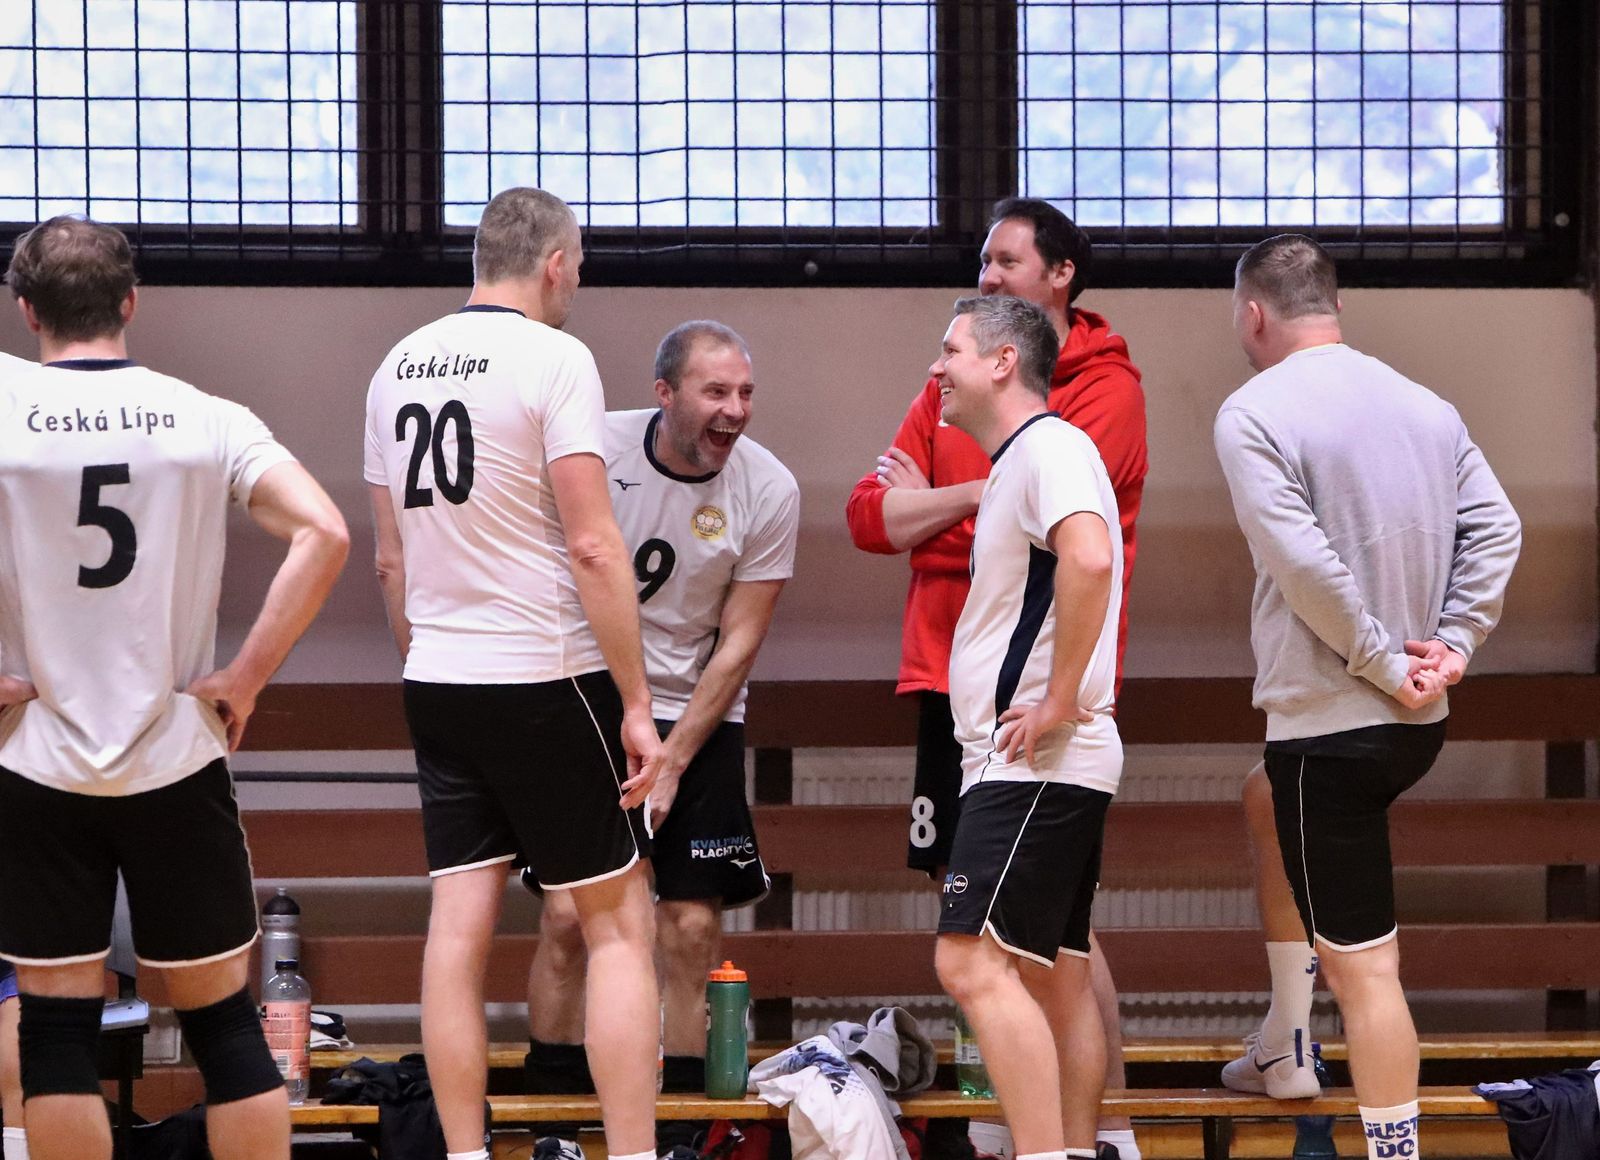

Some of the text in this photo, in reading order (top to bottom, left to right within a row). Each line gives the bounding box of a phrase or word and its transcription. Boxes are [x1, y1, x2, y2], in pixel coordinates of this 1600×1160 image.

[397, 352, 489, 381] Česká Lípa
[27, 404, 175, 435] Česká Lípa
[396, 400, 475, 509] 20
[77, 463, 137, 588] 5
[634, 538, 676, 604] 9
[909, 796, 937, 848] 8
[1365, 1117, 1418, 1139] JUST
[1375, 1139, 1415, 1158] DO
